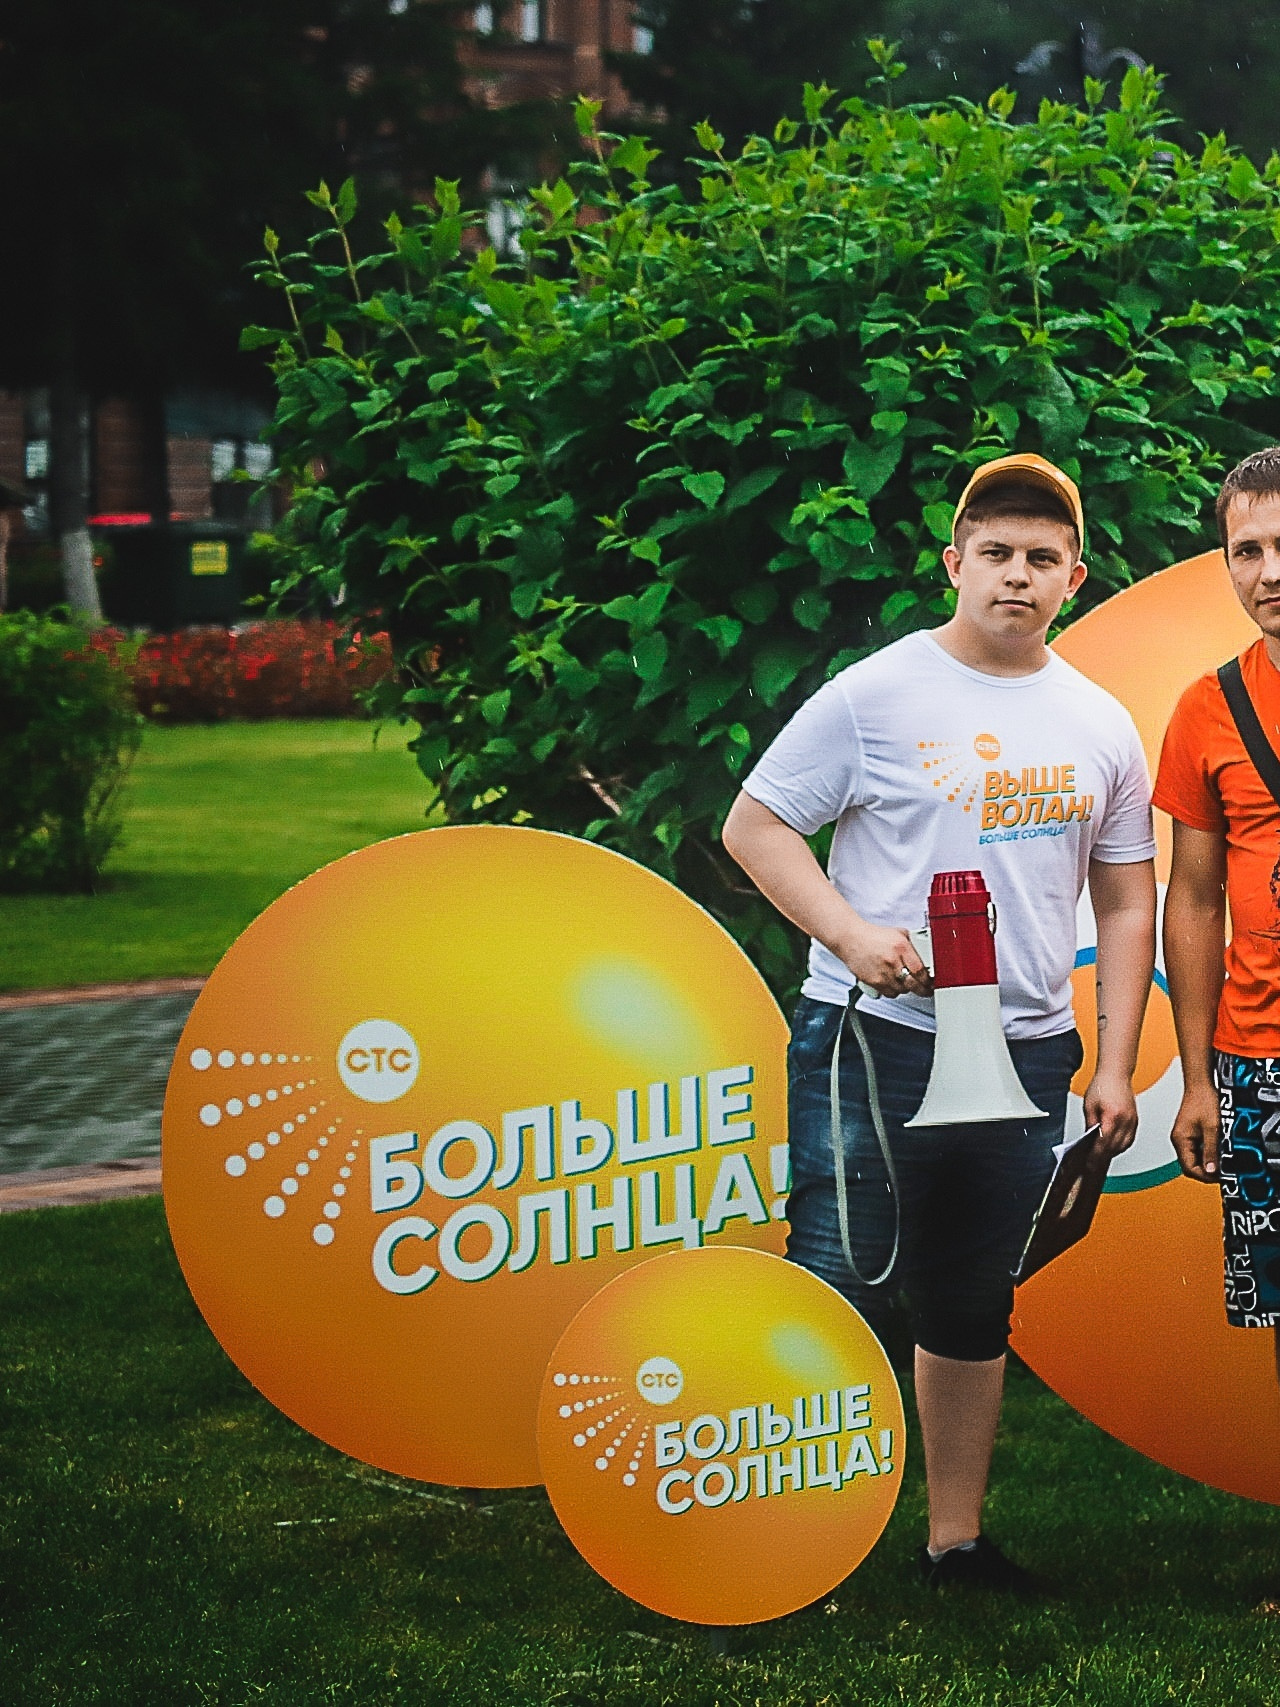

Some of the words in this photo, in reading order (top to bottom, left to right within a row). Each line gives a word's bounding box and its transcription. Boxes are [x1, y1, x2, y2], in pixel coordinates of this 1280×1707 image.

[984, 764, 1076, 800] ВЫШЕ
[980, 795, 1094, 830] ВОЛАН!
[978, 830, 1020, 845] БОЛЬШЕ
[345, 1047, 411, 1075] СТС
[368, 1064, 755, 1213] БОЛЬШЕ
[371, 1144, 790, 1295] СОЛНЦА!
[641, 1372, 679, 1389] СТС
[655, 1383, 872, 1469] БОЛЬШЕ
[656, 1431, 896, 1515] СОЛНЦА!
